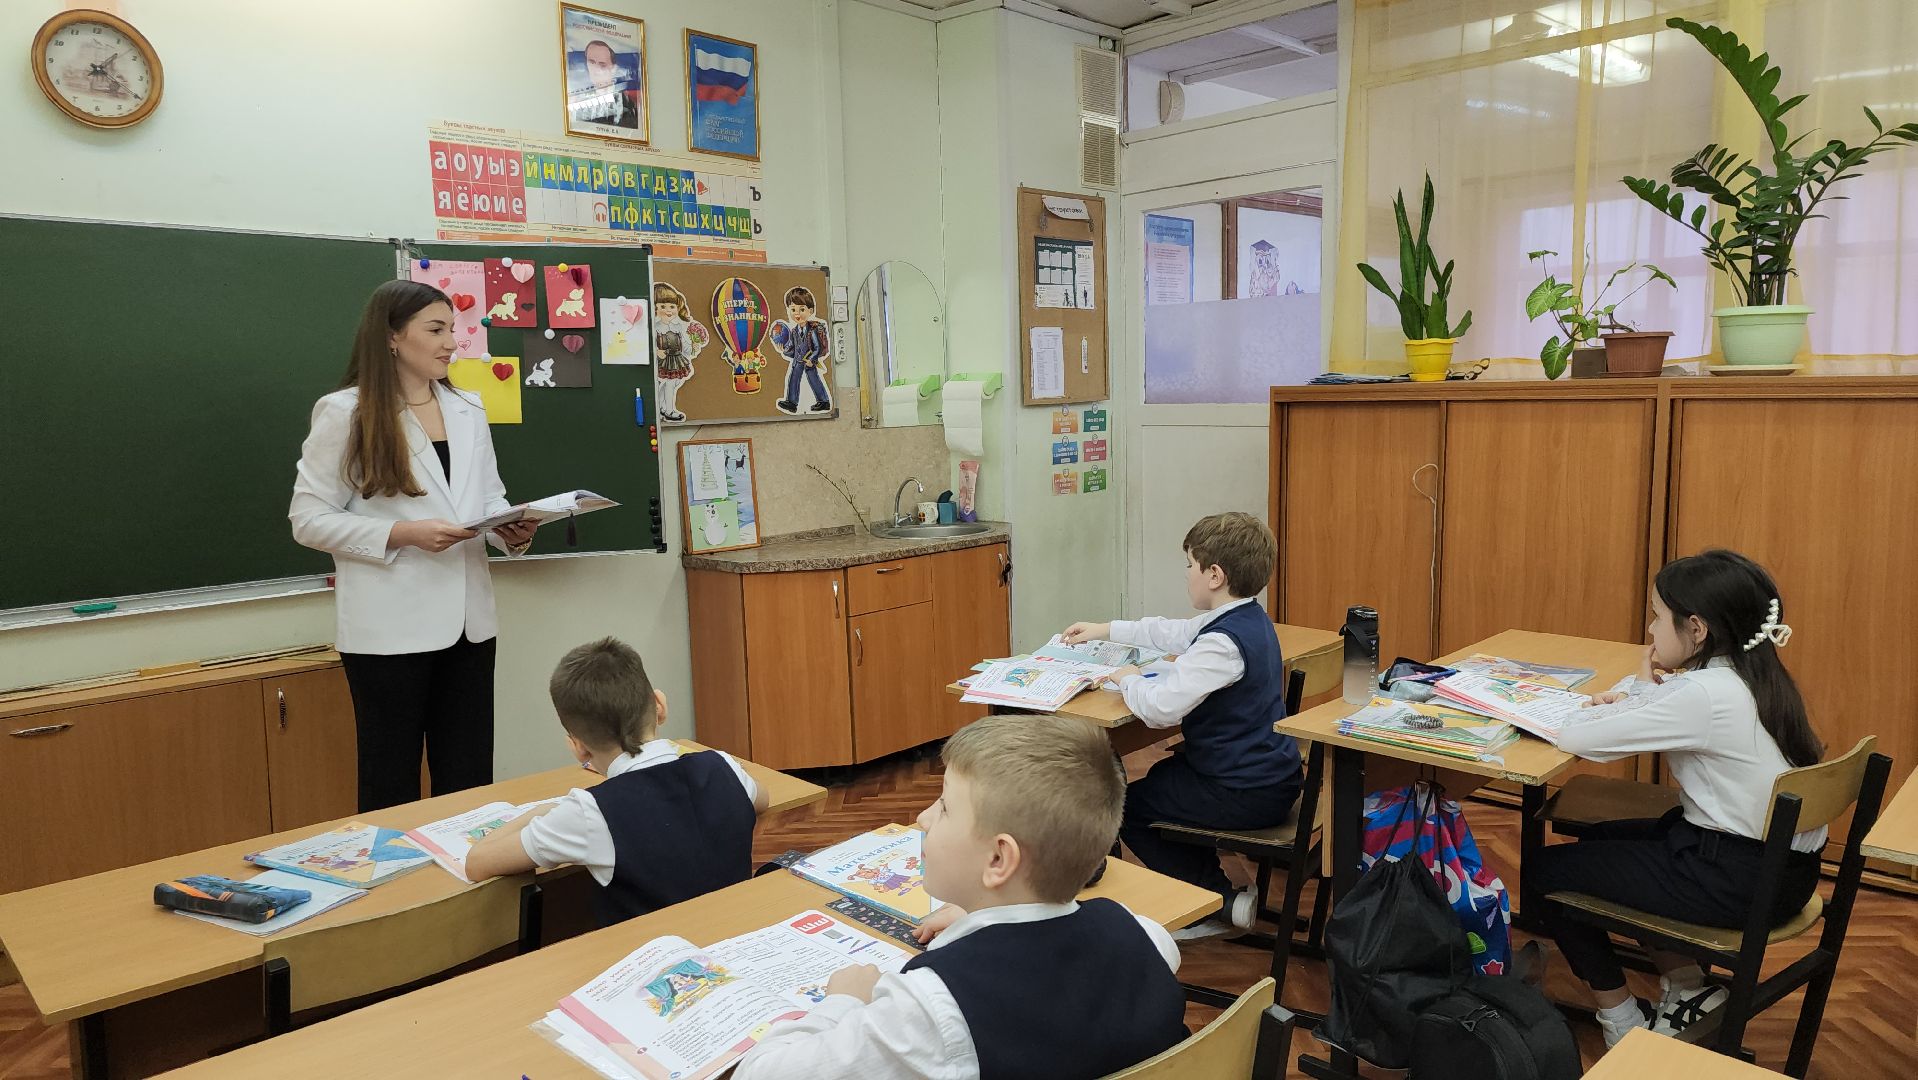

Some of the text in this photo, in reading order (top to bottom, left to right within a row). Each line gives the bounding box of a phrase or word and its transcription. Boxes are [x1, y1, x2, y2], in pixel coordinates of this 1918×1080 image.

[434, 151, 520, 179] а о у ы э
[525, 154, 695, 196] й н м л р б в г д з ж
[438, 185, 524, 215] я ё ю и е
[750, 186, 762, 201] ъ
[610, 201, 751, 237] п ф к т с ш х ц ч щ
[753, 219, 762, 234] ь
[827, 836, 914, 876] Математика
